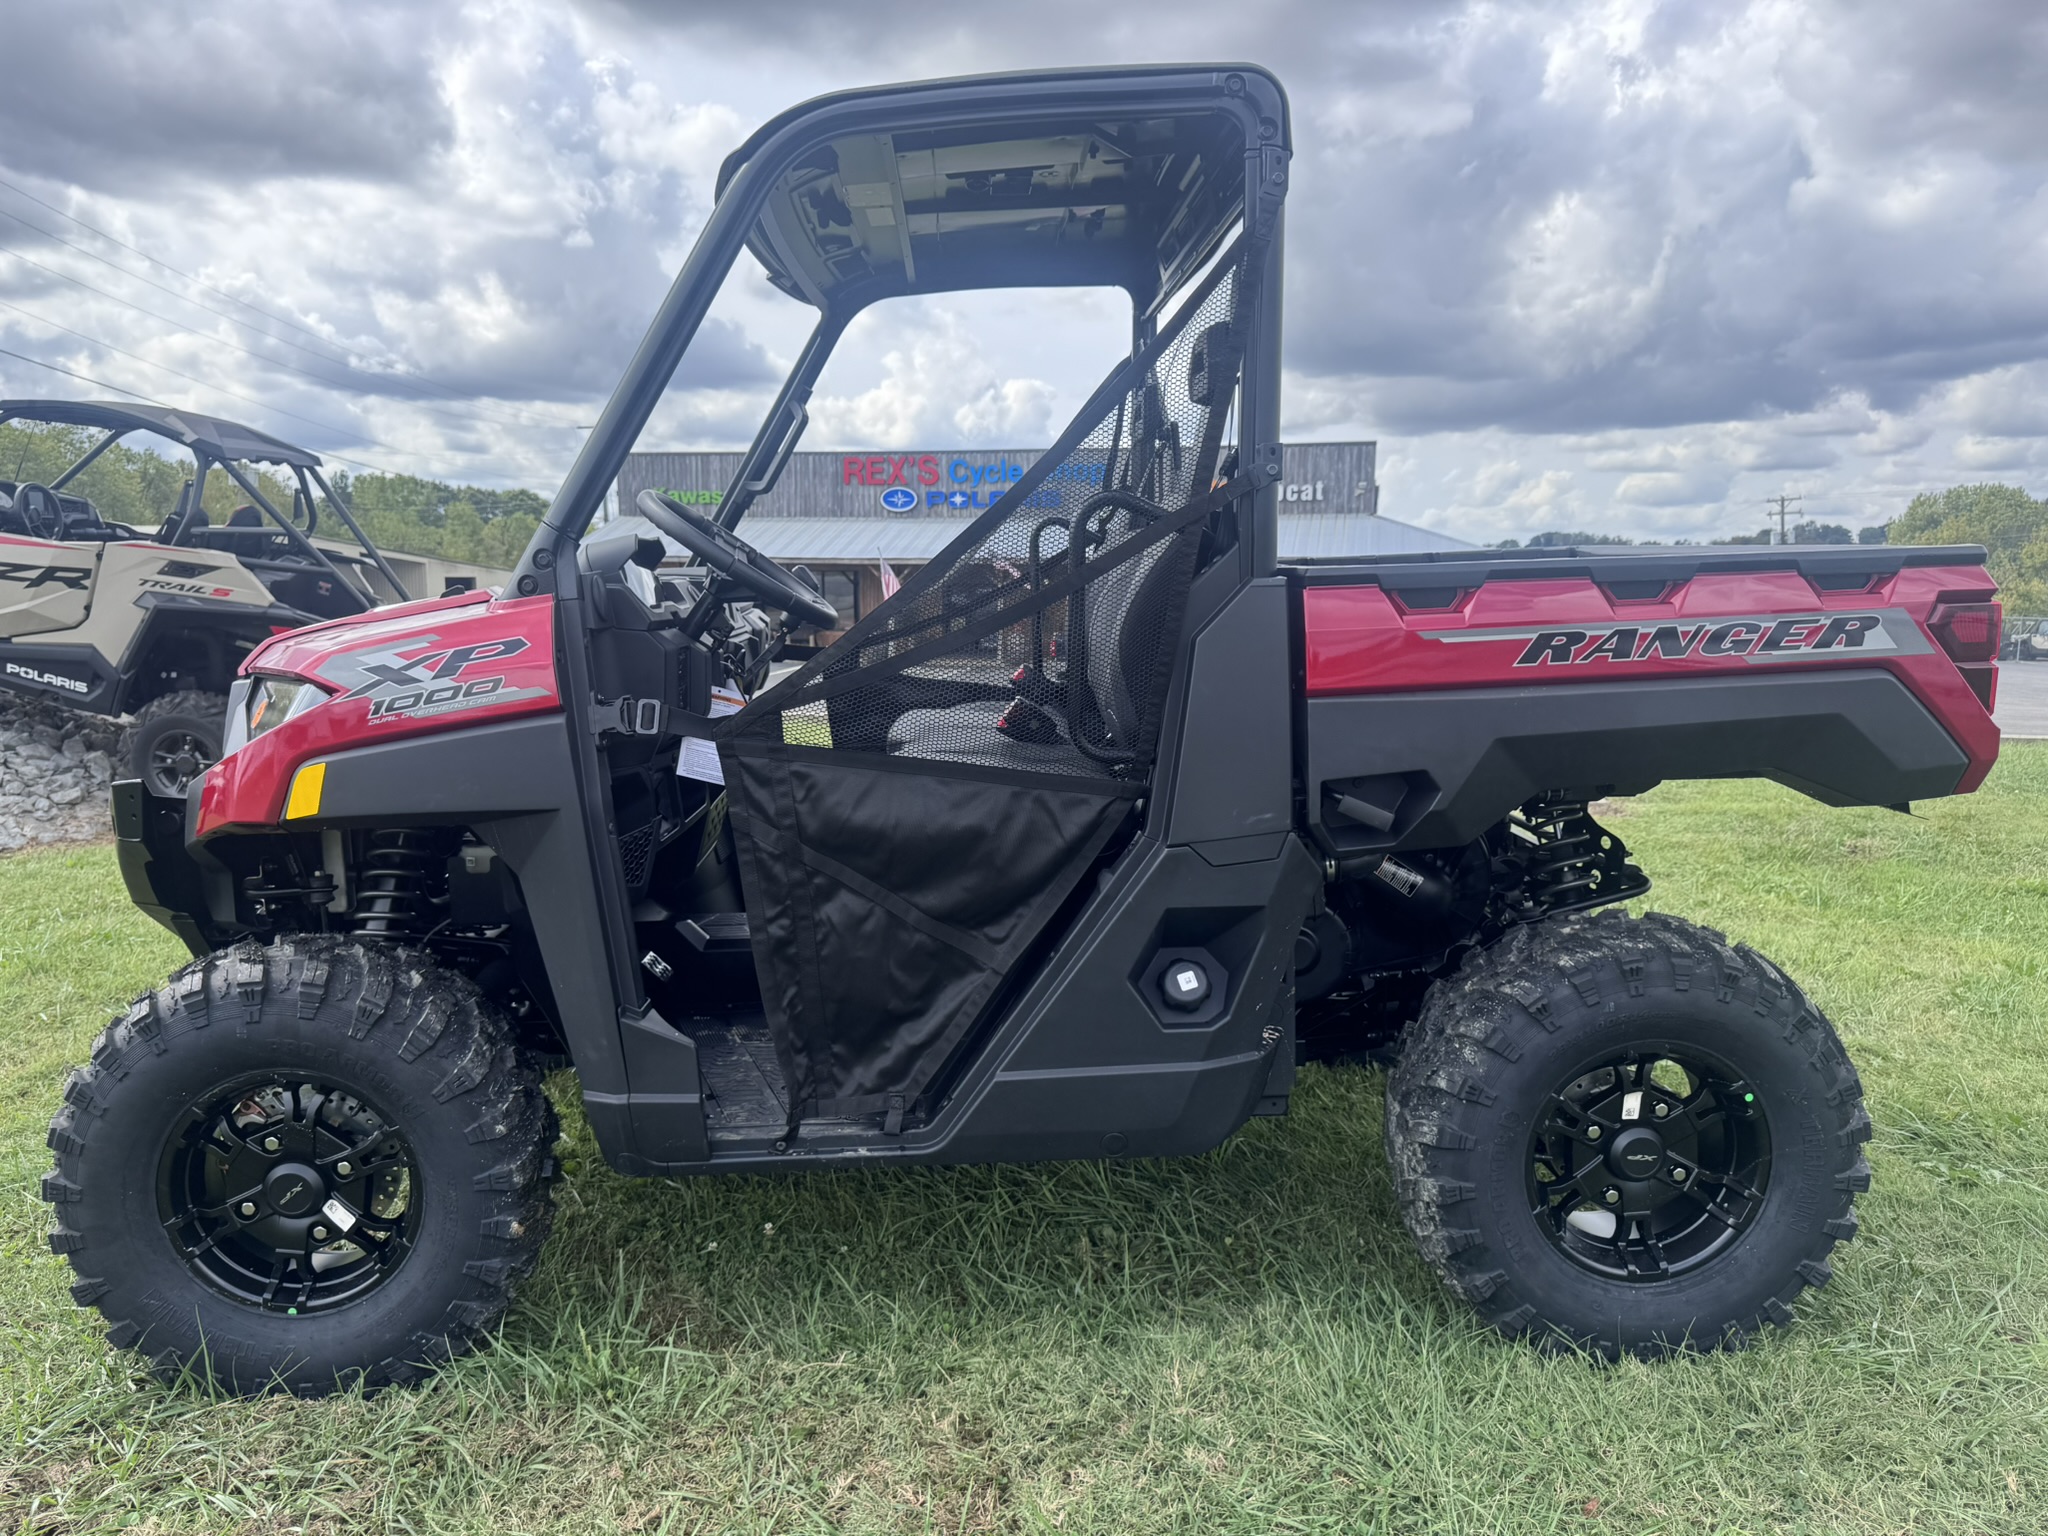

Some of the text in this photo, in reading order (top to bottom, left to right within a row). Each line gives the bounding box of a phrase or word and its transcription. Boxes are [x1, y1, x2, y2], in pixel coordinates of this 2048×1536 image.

[843, 455, 940, 486] REX'S
[950, 459, 1023, 487] Cycle
[653, 487, 723, 505] awas
[926, 490, 1060, 508] POLIS
[139, 578, 234, 597] TRAIL S
[1513, 614, 1882, 666] RANGER
[6, 663, 88, 693] POLARIS
[335, 636, 532, 702] XP
[367, 675, 506, 719] 1000
[368, 695, 497, 726] DUAL OVERHEAD CAM
